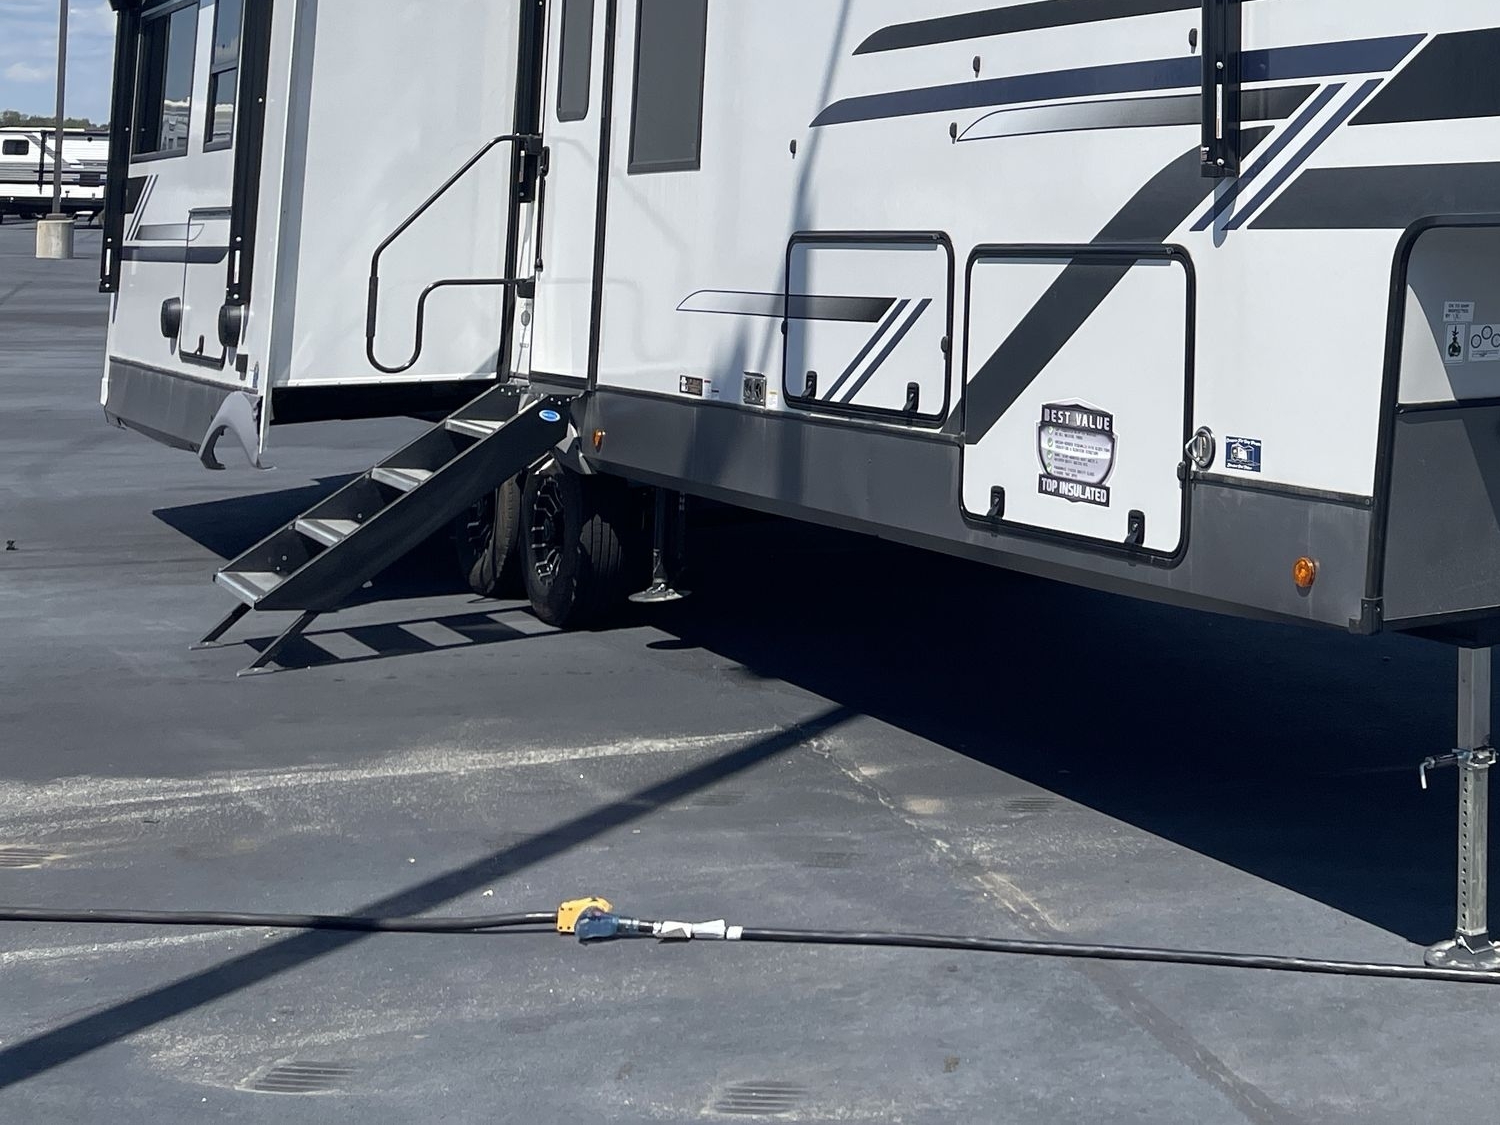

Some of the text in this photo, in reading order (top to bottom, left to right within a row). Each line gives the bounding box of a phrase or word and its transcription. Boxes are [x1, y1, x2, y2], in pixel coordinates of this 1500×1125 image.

[1043, 408, 1110, 431] BEST VALUE
[1041, 477, 1107, 503] TOP INSULATED
